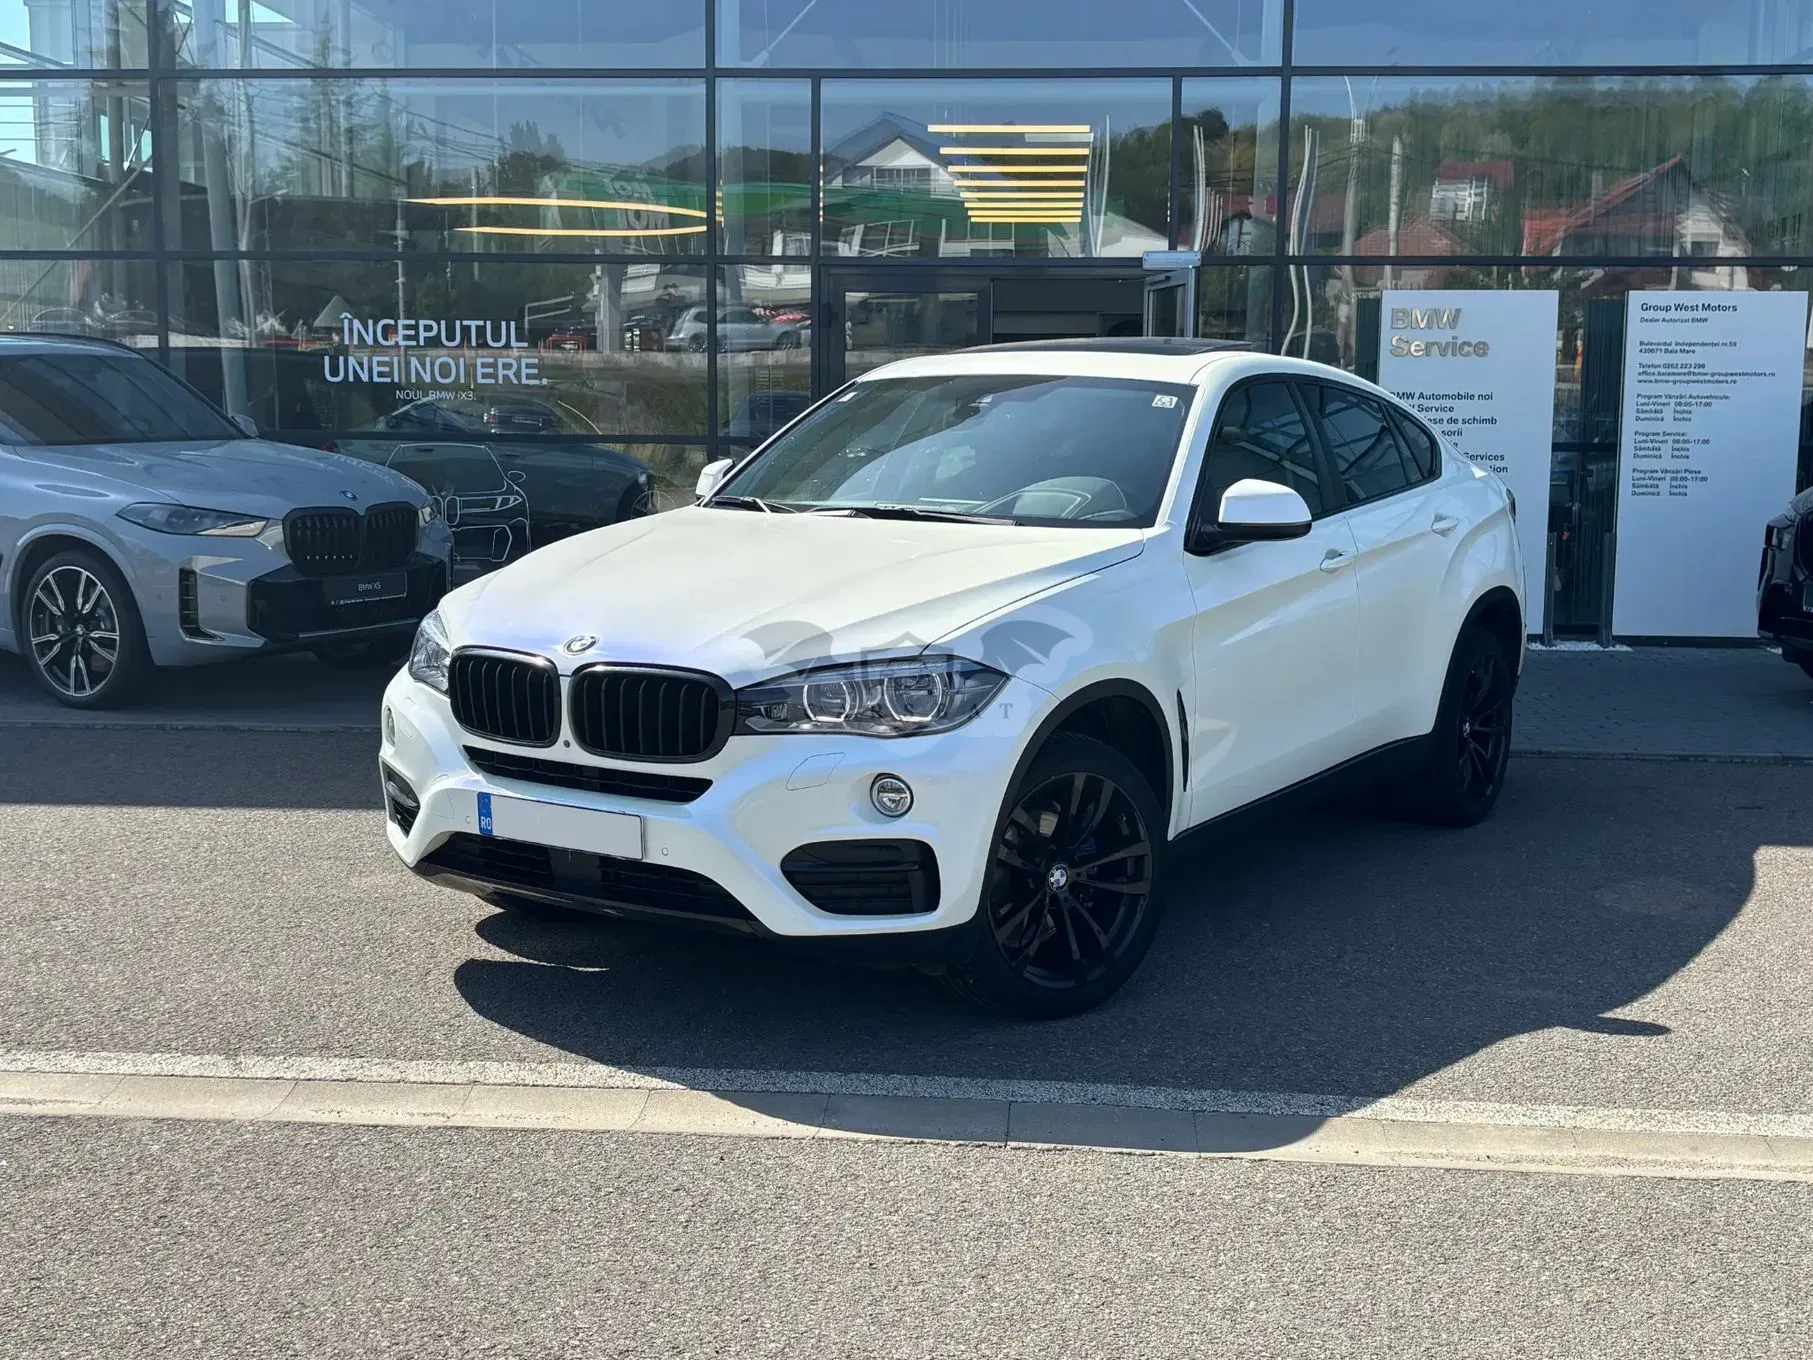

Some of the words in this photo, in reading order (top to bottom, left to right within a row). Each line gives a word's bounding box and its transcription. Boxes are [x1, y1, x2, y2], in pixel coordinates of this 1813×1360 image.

[1640, 302, 1672, 314] Group
[1674, 302, 1699, 312] West
[1701, 303, 1738, 312] Motors
[1391, 307, 1462, 330] BMW
[339, 312, 529, 348] ÎNCEPUTUL
[1391, 335, 1490, 358] Service
[323, 355, 399, 383] UNEI
[410, 356, 464, 384] NOI
[476, 357, 548, 385] ERE.
[395, 390, 428, 400] NOUL
[429, 390, 455, 400] BMW
[1418, 391, 1475, 401] Automobile
[1477, 392, 1493, 400] noi
[1417, 403, 1455, 413] Service
[1446, 416, 1459, 424] de
[1461, 416, 1497, 425] schimb
[358, 583, 373, 591] BMW
[481, 816, 492, 830] RO
